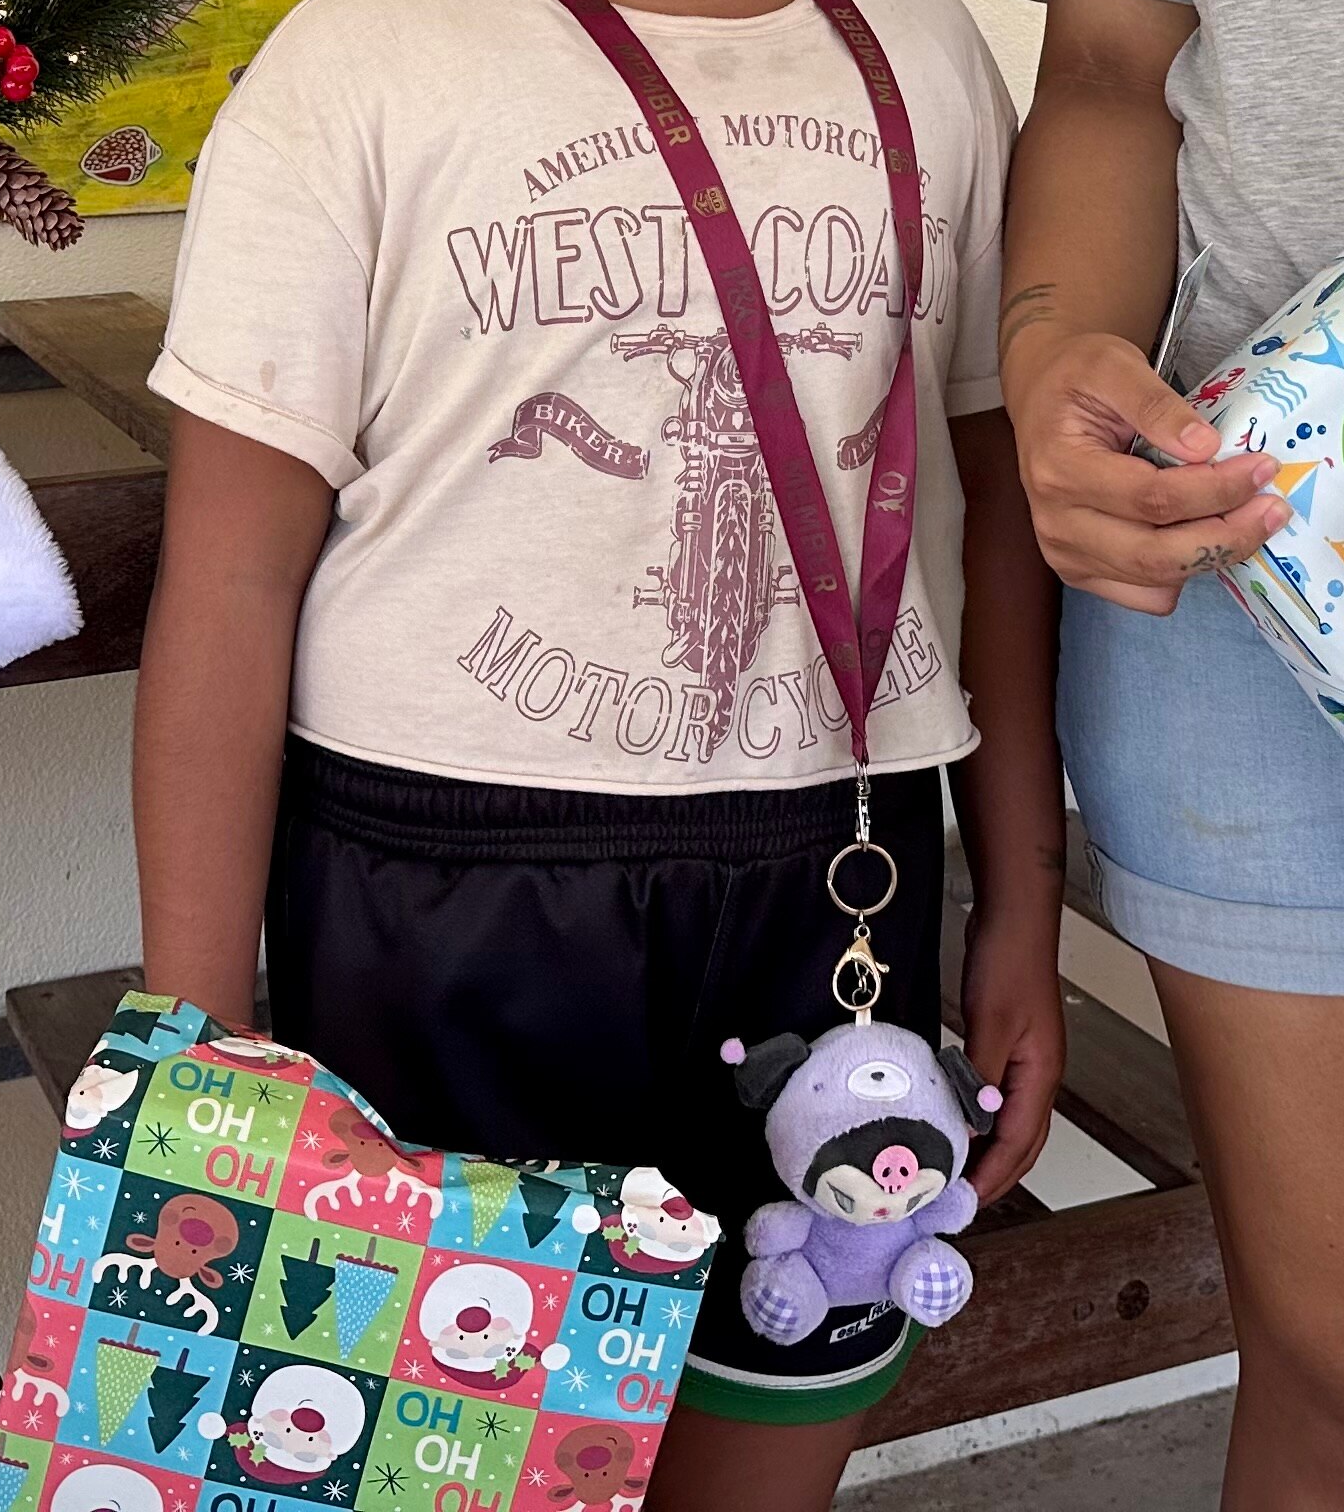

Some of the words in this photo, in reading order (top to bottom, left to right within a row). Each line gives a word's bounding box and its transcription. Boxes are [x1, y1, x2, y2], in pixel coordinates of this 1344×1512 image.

[612, 42, 692, 147] MEMBER
[832, 6, 898, 106] MEMBER
[448, 203, 693, 336] WEST
[533, 403, 623, 465] BIKER
